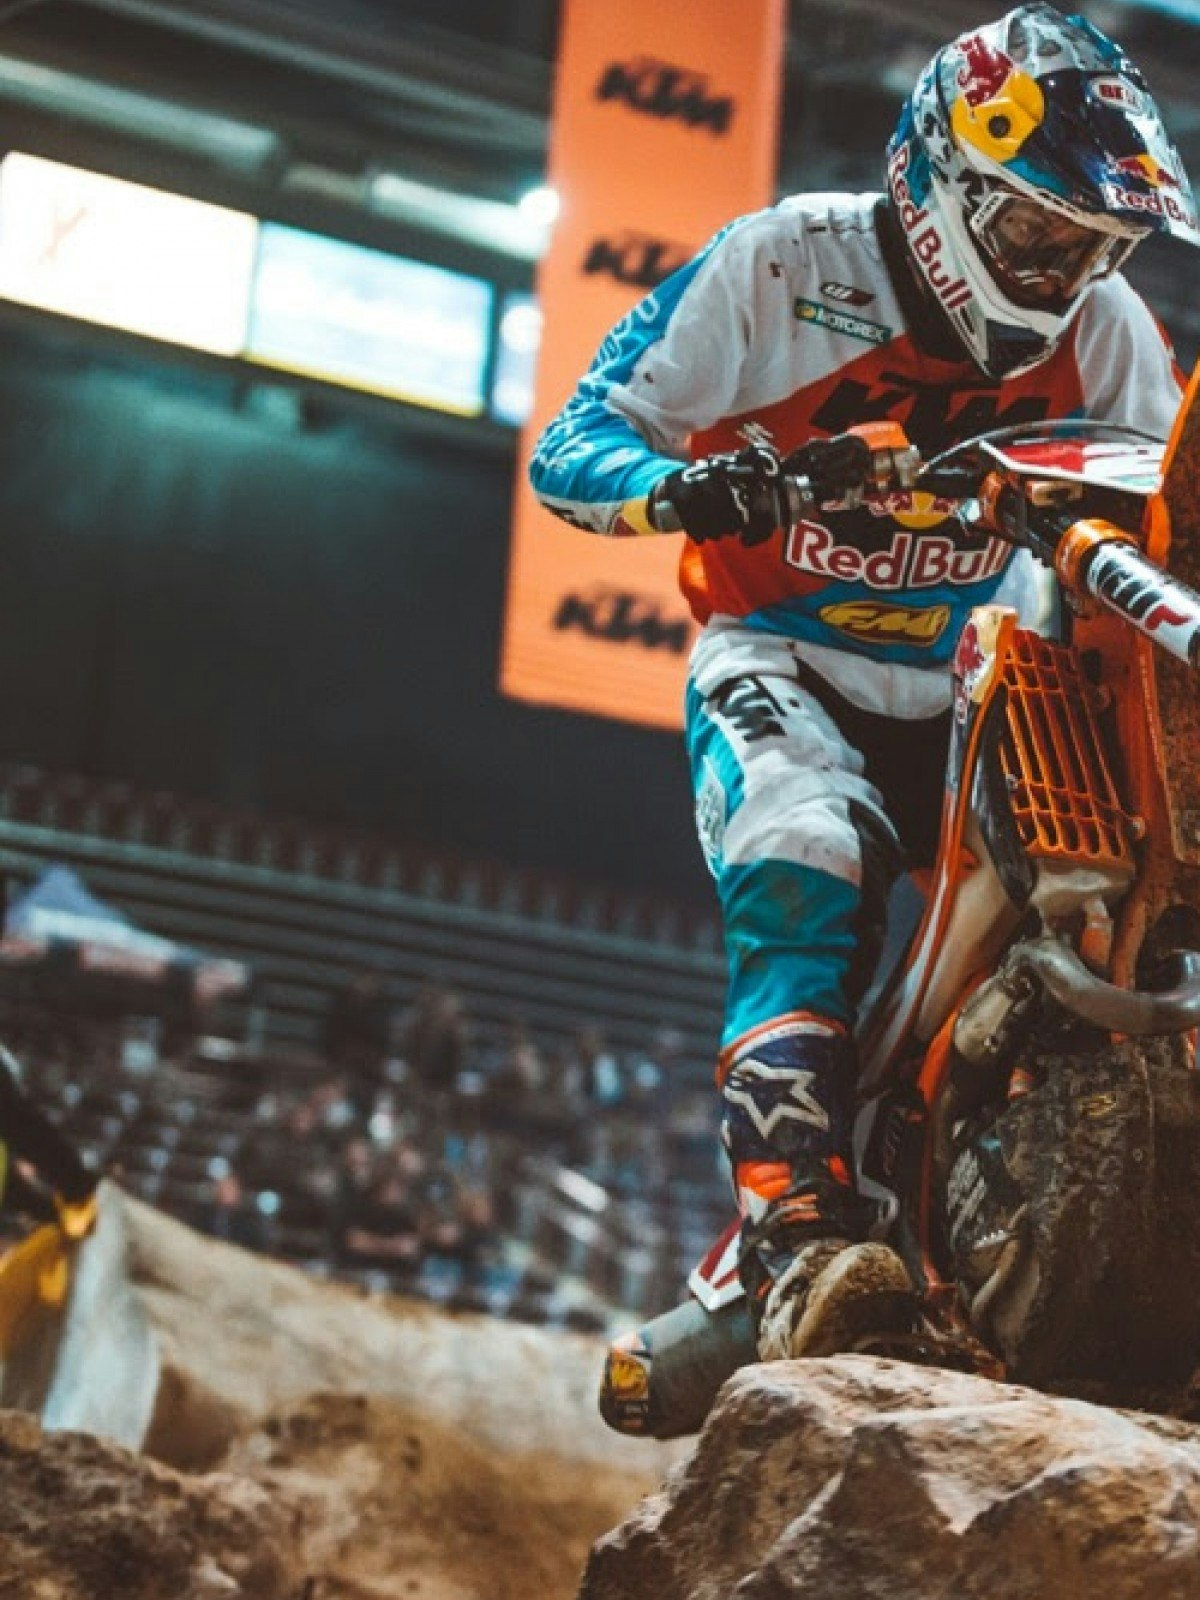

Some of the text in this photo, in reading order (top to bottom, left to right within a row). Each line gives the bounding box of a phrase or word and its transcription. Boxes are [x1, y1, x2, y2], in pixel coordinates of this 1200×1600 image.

[595, 60, 733, 137] KTM
[890, 146, 973, 309] Red Bull
[1110, 187, 1162, 214] Red
[786, 519, 912, 590] Red
[553, 584, 692, 655] KTM
